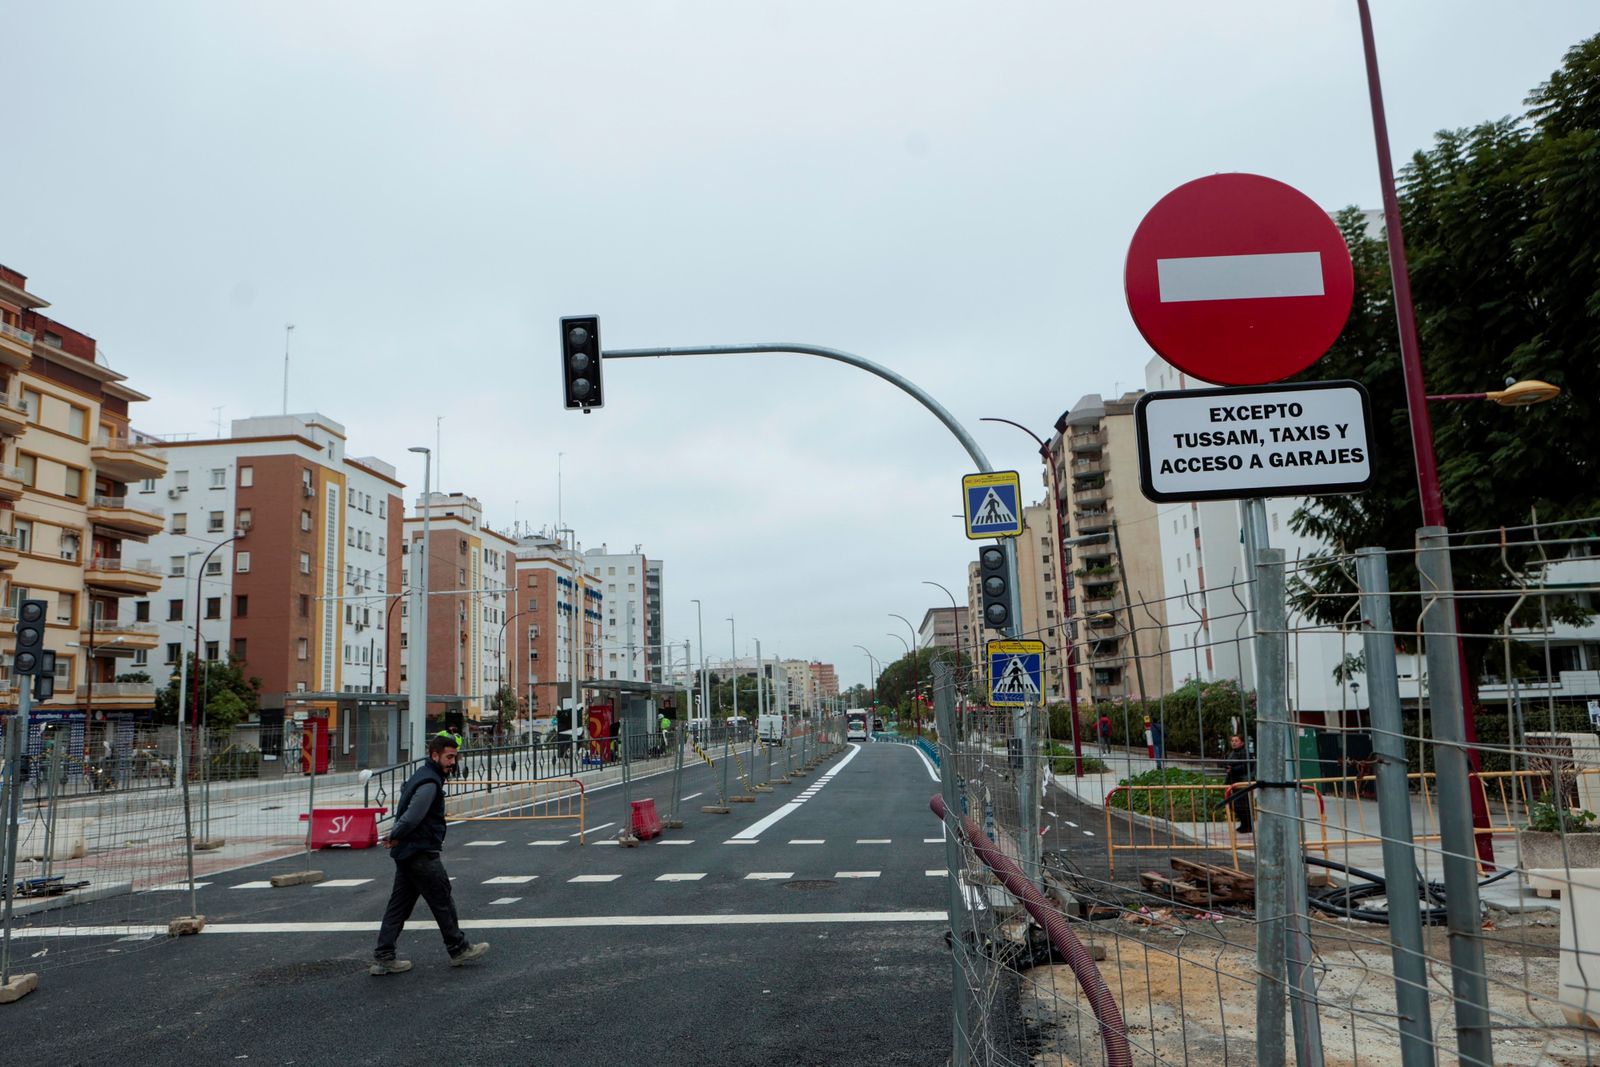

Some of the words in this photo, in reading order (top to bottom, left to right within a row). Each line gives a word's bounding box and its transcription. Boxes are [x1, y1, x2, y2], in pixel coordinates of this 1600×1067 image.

[1209, 402, 1303, 423] EXCEPTO
[1173, 429, 1265, 449] TUSSAM,
[1269, 424, 1331, 443] TAXIS
[1335, 423, 1349, 439] Y
[1160, 454, 1243, 475] ACCESO
[1249, 453, 1264, 469] A
[1268, 447, 1365, 468] GARAJES
